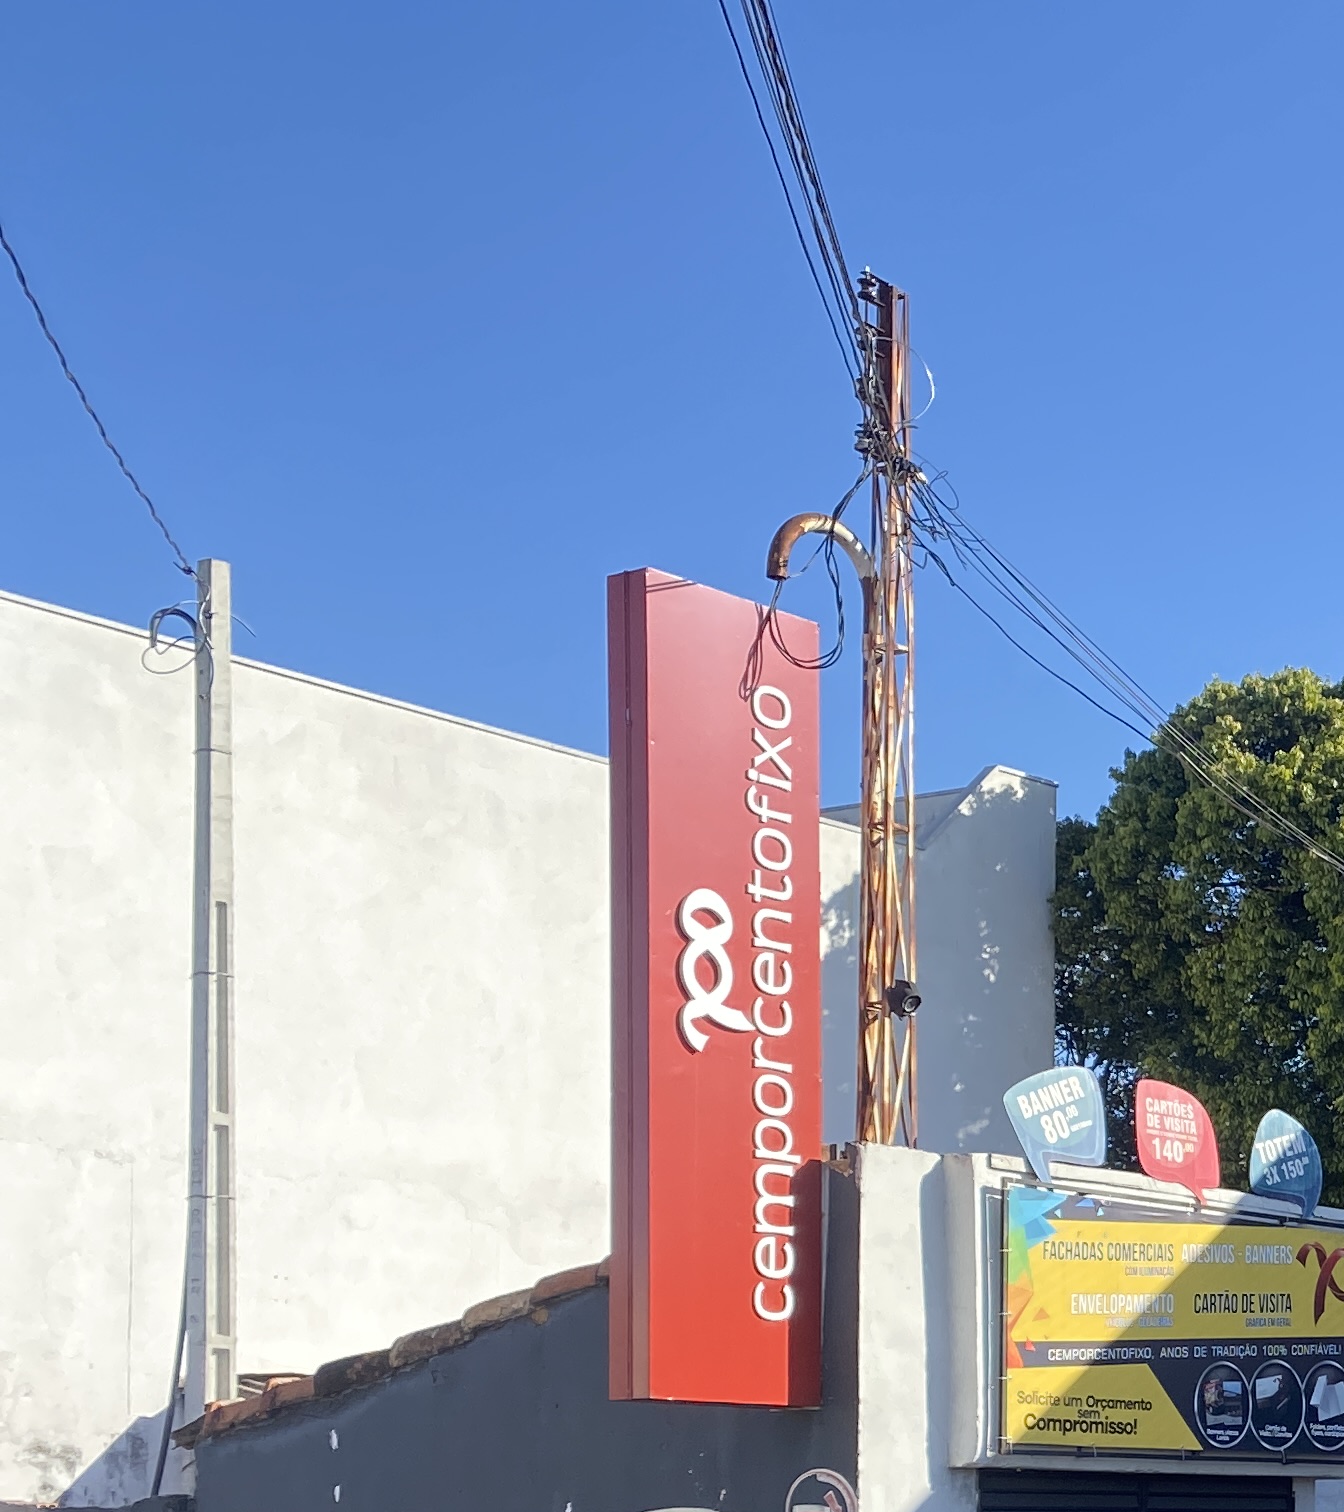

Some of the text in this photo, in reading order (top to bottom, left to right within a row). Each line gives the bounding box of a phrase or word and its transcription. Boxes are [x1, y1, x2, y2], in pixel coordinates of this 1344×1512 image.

[744, 684, 801, 1322] cemporcentofixo
[1016, 1076, 1085, 1119] BANNER
[1145, 1097, 1194, 1119] CARTÕES
[1146, 1113, 1160, 1129] DE
[1162, 1116, 1198, 1136] VISITA
[1254, 1131, 1307, 1164] TOTEM
[1263, 1164, 1281, 1186] 3X
[1042, 1240, 1174, 1261] FACHADAS COMERCIAIS
[1181, 1243, 1235, 1264] ADESIVOS
[1245, 1245, 1293, 1264] BANNERS
[1071, 1293, 1174, 1315] ENVELOPAMENTO
[1194, 1290, 1292, 1314] CARTÃO DE VISITA
[1048, 1342, 1342, 1360] CEMPORCENTOFIXO, ANOS DE TRADIÇÃO 100% CONFIÁVEL!
[1017, 1390, 1152, 1411] Solicite um Orçamento
[1024, 1413, 1138, 1436] Compromisso!
[1078, 1409, 1100, 1419] sem
